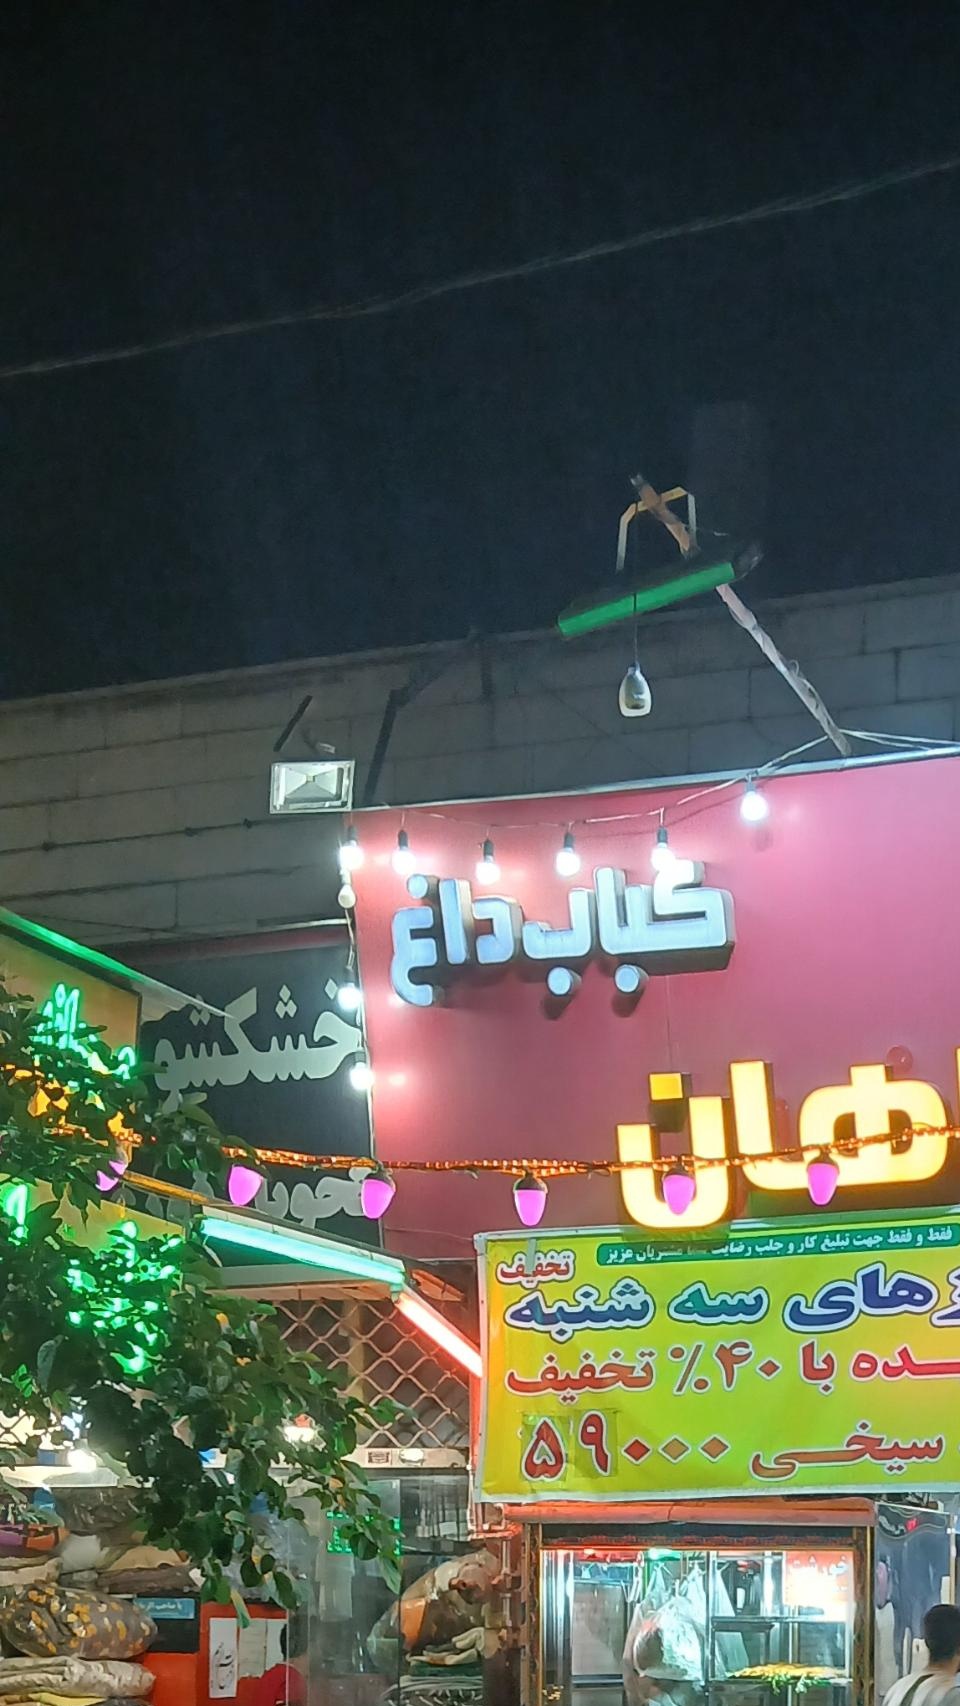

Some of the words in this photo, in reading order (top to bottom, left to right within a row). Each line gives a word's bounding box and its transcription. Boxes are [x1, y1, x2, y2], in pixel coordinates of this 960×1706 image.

[522, 858, 735, 996] کباب
[390, 873, 517, 1007] داغ
[820, 1233, 850, 1252] تبلیغ
[852, 1233, 883, 1248] جهت
[887, 1228, 912, 1243] فقط
[915, 1233, 923, 1247] و
[927, 1225, 953, 1241] فقط
[755, 1238, 784, 1255] جلب
[787, 1241, 795, 1254] و
[797, 1234, 818, 1253] کار
[606, 1246, 634, 1264] عزیز
[499, 1253, 573, 1285] تخفیف
[507, 1280, 652, 1340] شنبه
[671, 1284, 766, 1322] سه
[800, 1339, 837, 1394] با
[506, 1350, 656, 1404] تخفیف
[750, 1420, 945, 1479] سیخی
